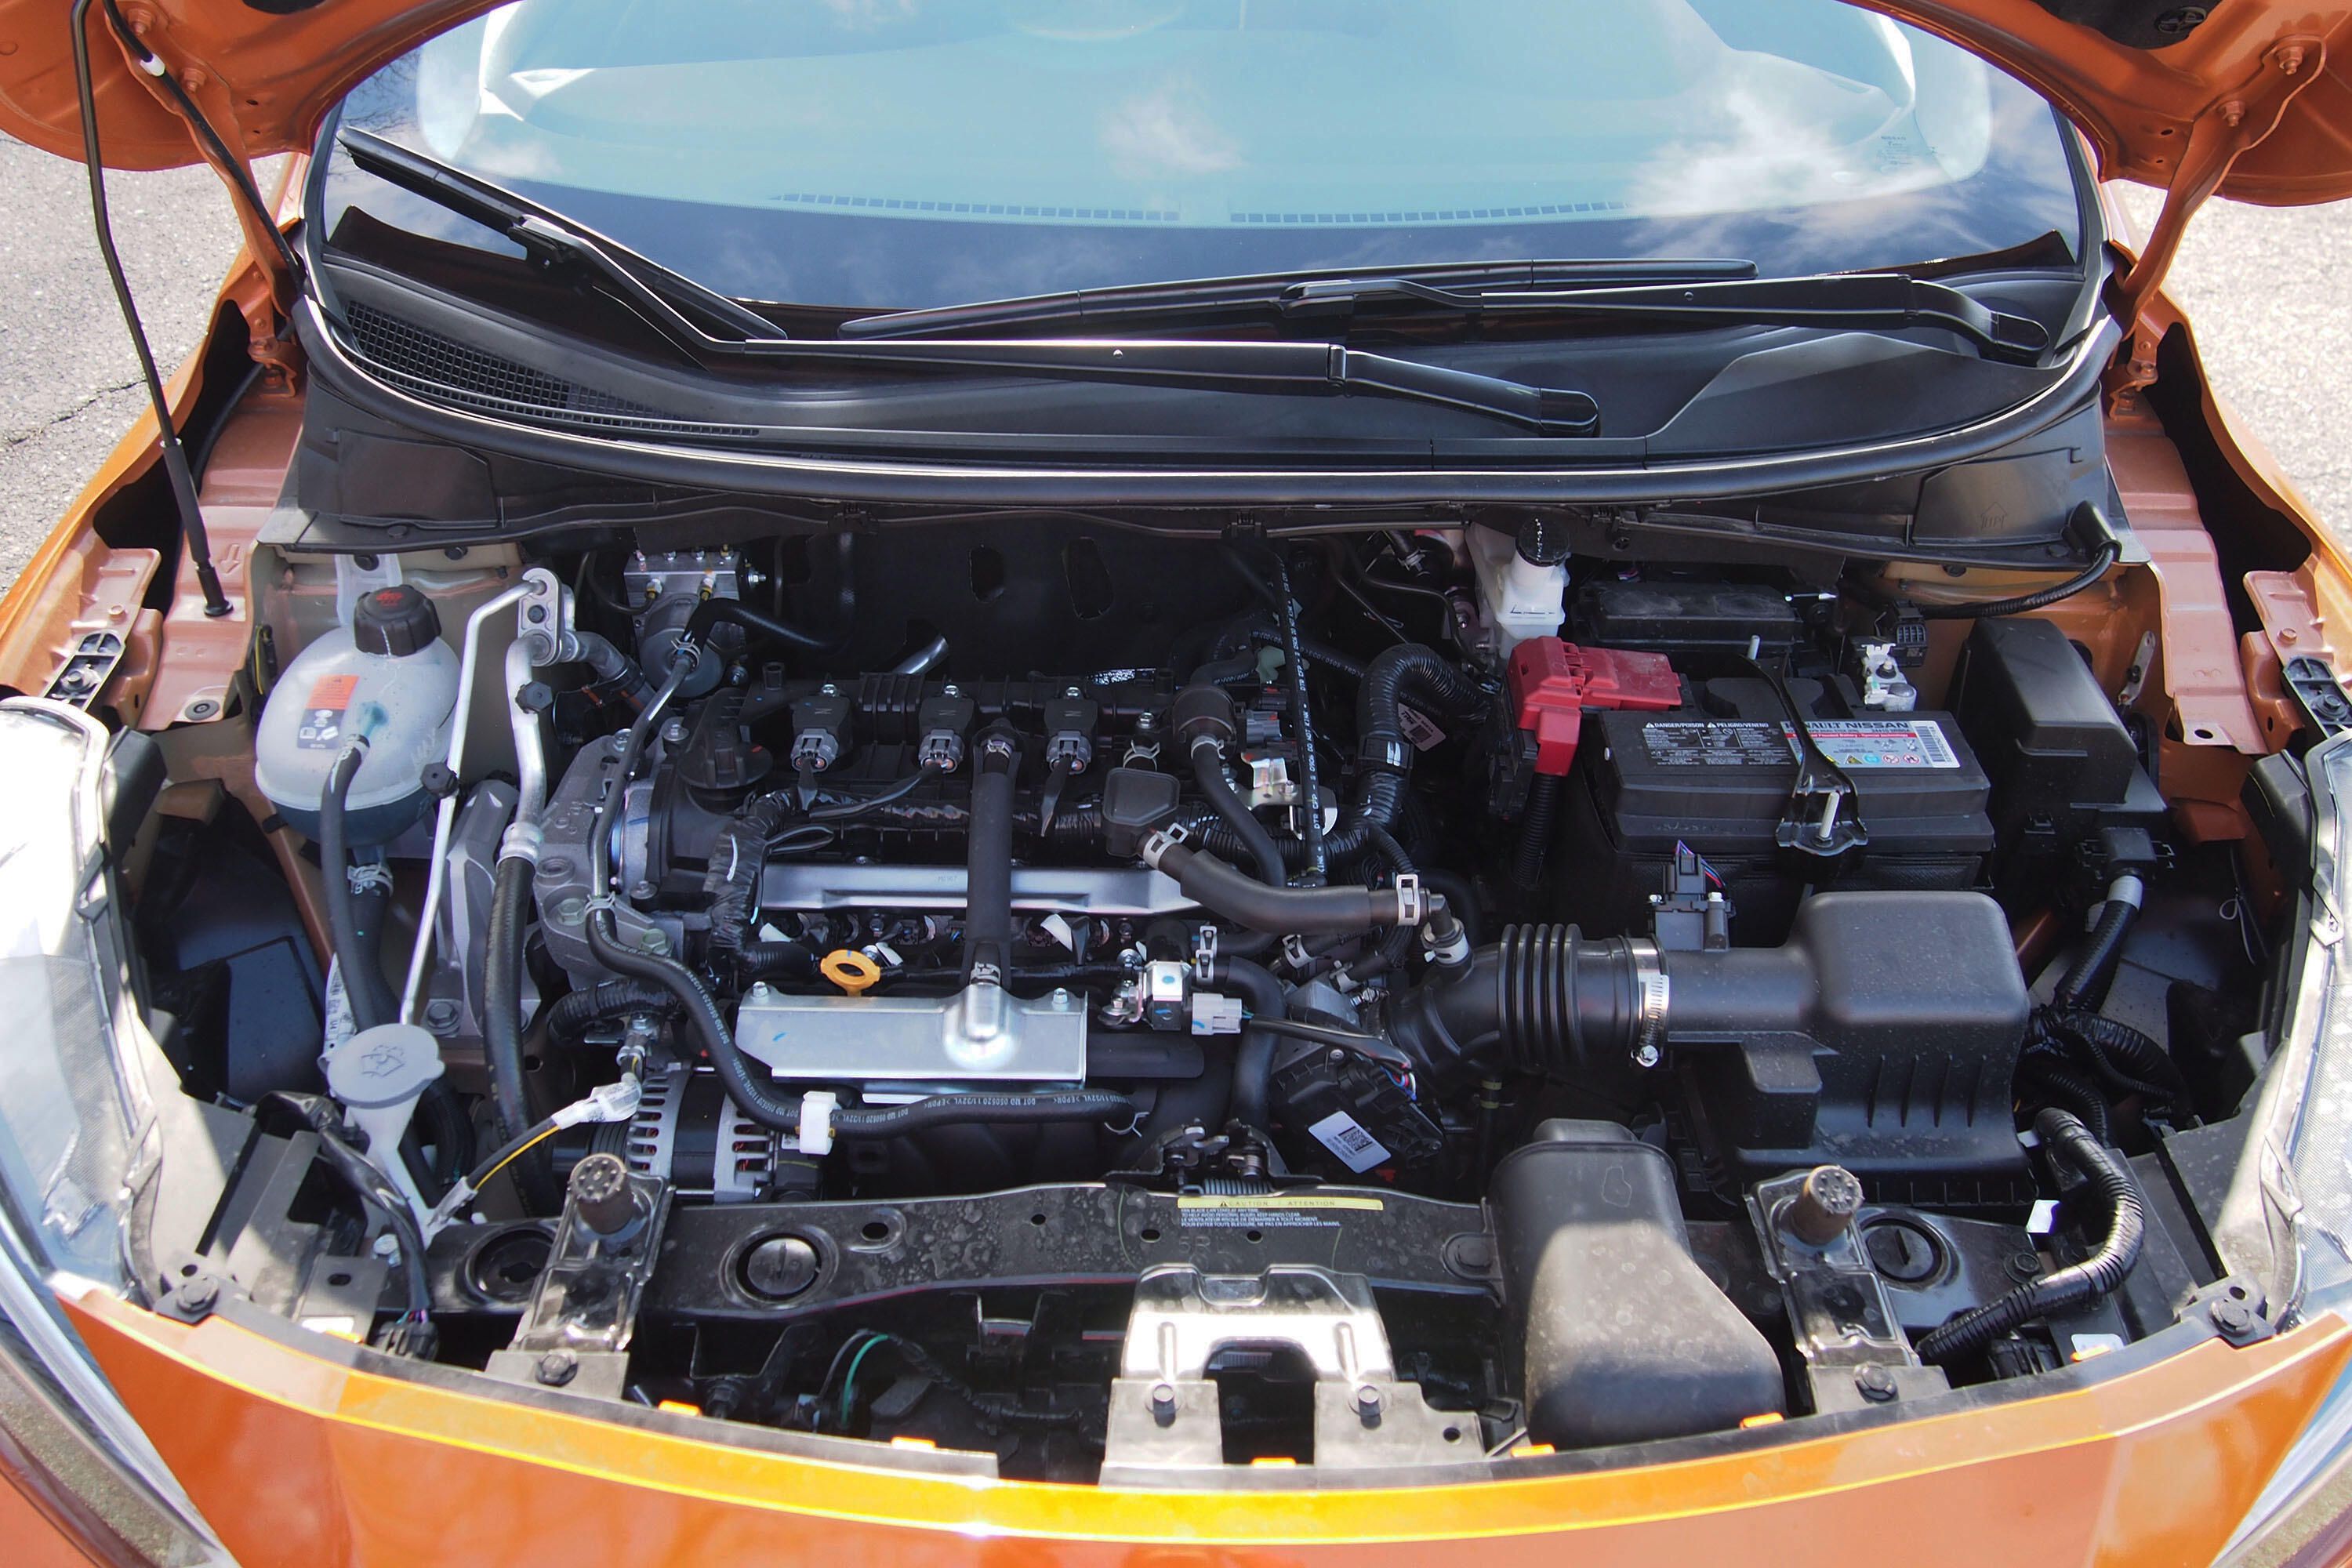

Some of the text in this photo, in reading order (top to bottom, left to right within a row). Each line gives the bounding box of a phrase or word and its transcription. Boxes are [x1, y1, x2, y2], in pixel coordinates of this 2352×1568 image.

[1307, 742, 1314, 752] DO
[982, 1098, 1009, 1106] 050520
[1024, 1098, 1036, 1106] DOT
